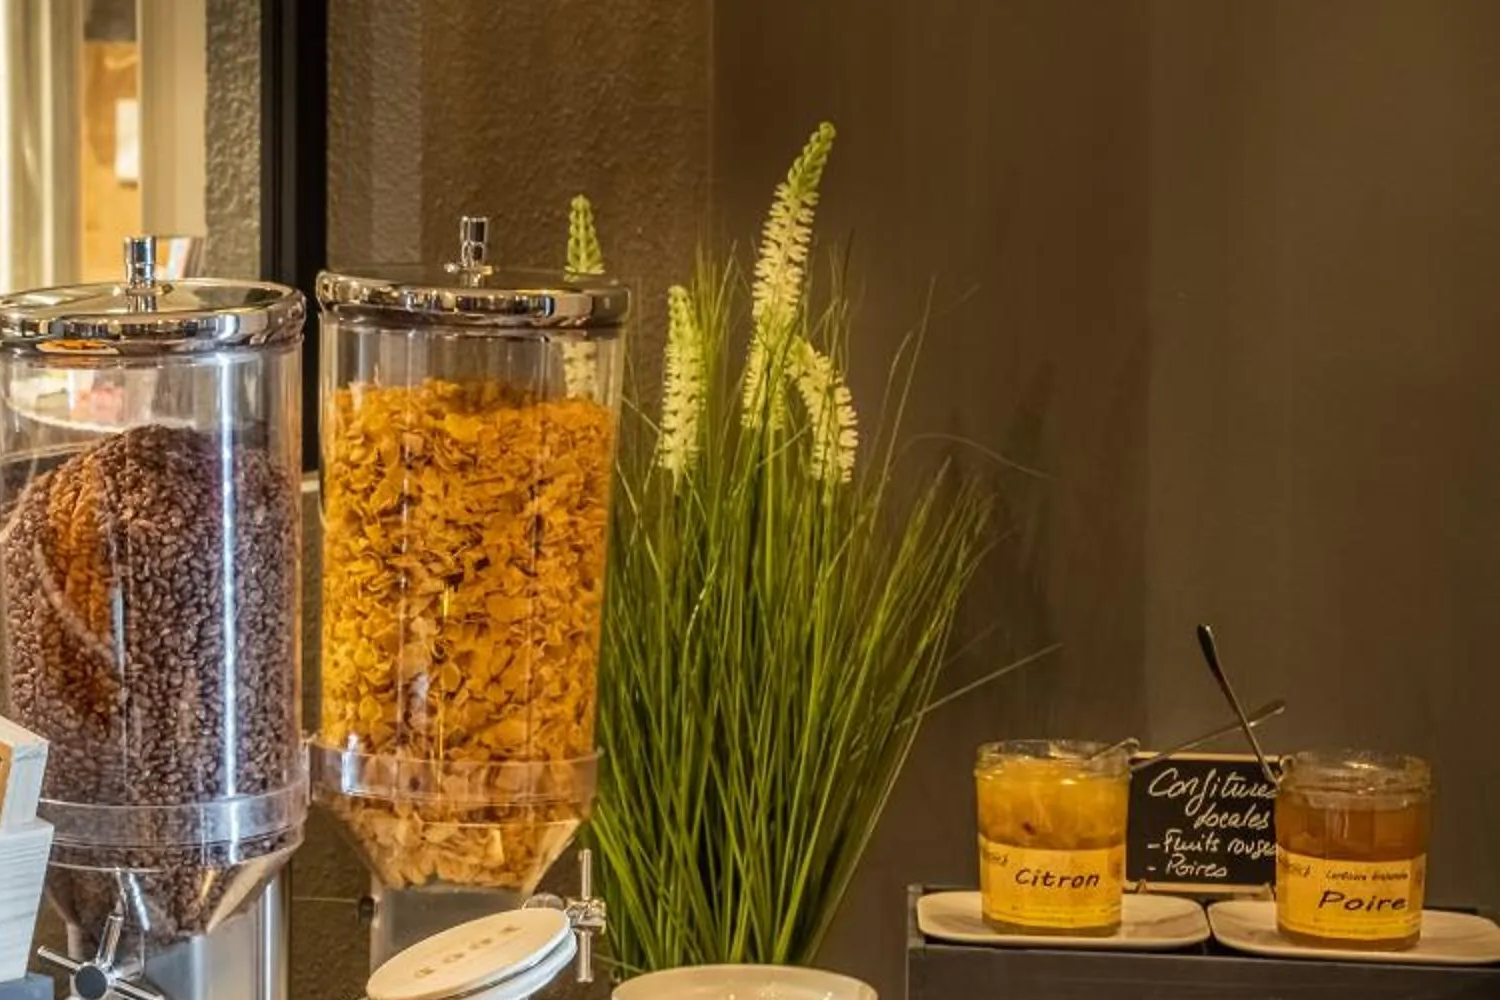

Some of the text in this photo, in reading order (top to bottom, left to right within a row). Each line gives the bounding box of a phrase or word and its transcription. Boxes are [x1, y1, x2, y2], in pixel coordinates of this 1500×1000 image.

[1163, 828, 1221, 853] Fruits
[1165, 853, 1229, 878] Poires
[1014, 867, 1100, 889] Citron
[1318, 889, 1407, 912] Poire
